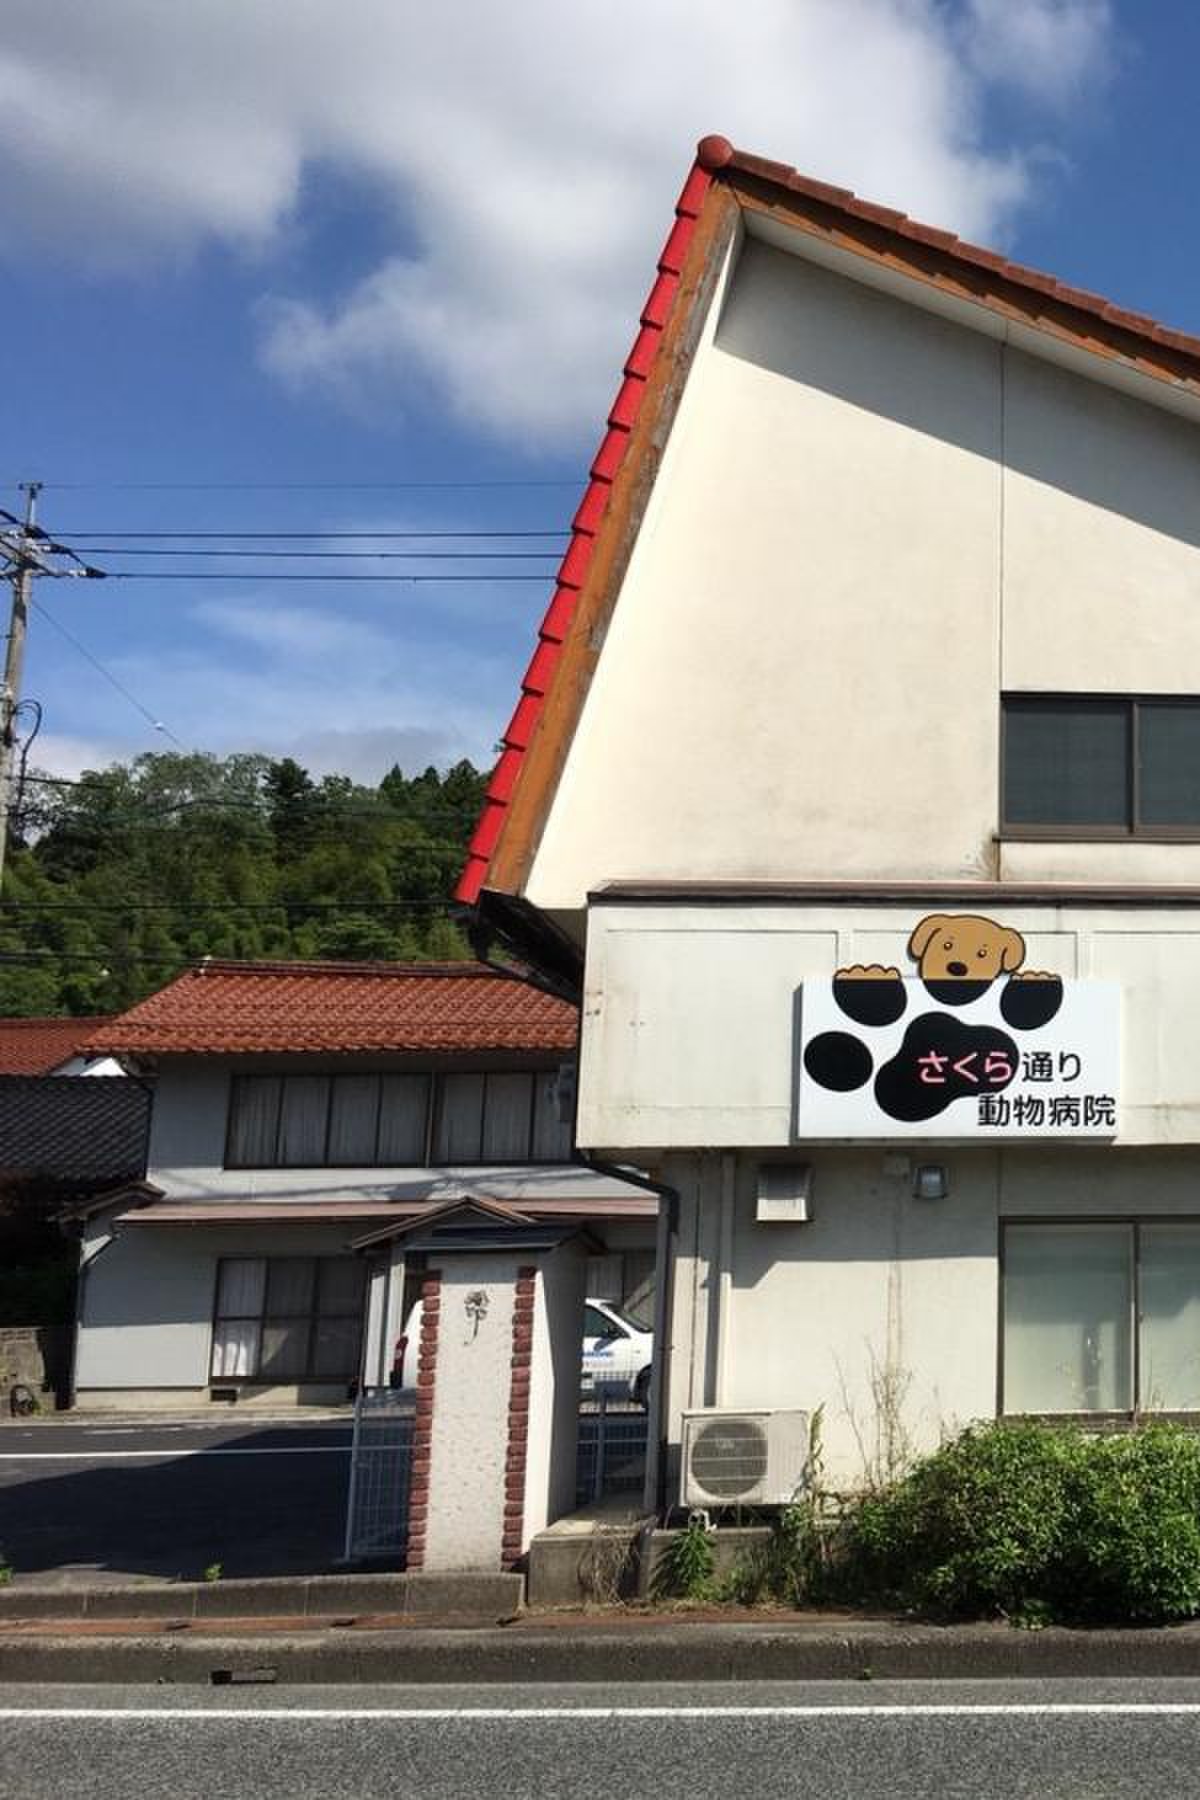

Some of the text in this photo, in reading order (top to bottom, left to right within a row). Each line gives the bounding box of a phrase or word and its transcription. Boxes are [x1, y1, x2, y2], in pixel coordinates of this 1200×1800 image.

[918, 1050, 1081, 1083] さくら通り
[977, 1094, 1116, 1127] 動物病院
